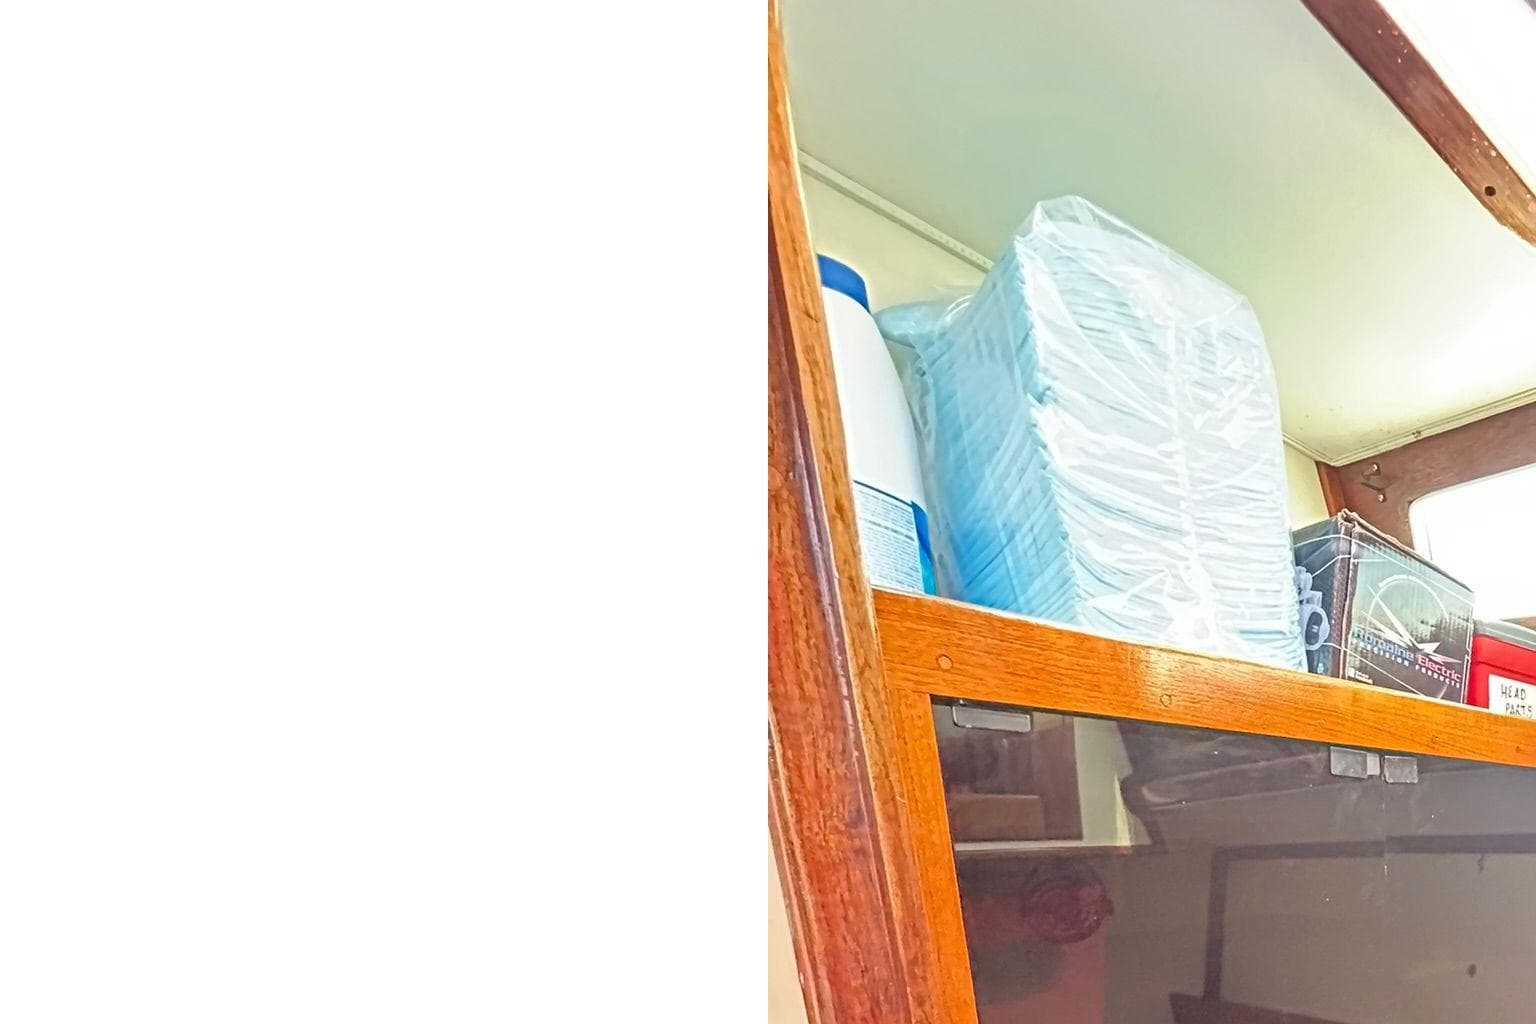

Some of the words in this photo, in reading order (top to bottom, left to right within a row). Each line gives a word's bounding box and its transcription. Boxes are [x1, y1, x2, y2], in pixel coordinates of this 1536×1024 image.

[1354, 627, 1415, 662] Romaine
[1416, 654, 1462, 682] Electric
[1415, 664, 1461, 688] PRODUCTS
[1500, 683, 1527, 701] HEAD
[1505, 702, 1533, 718] PARTS
